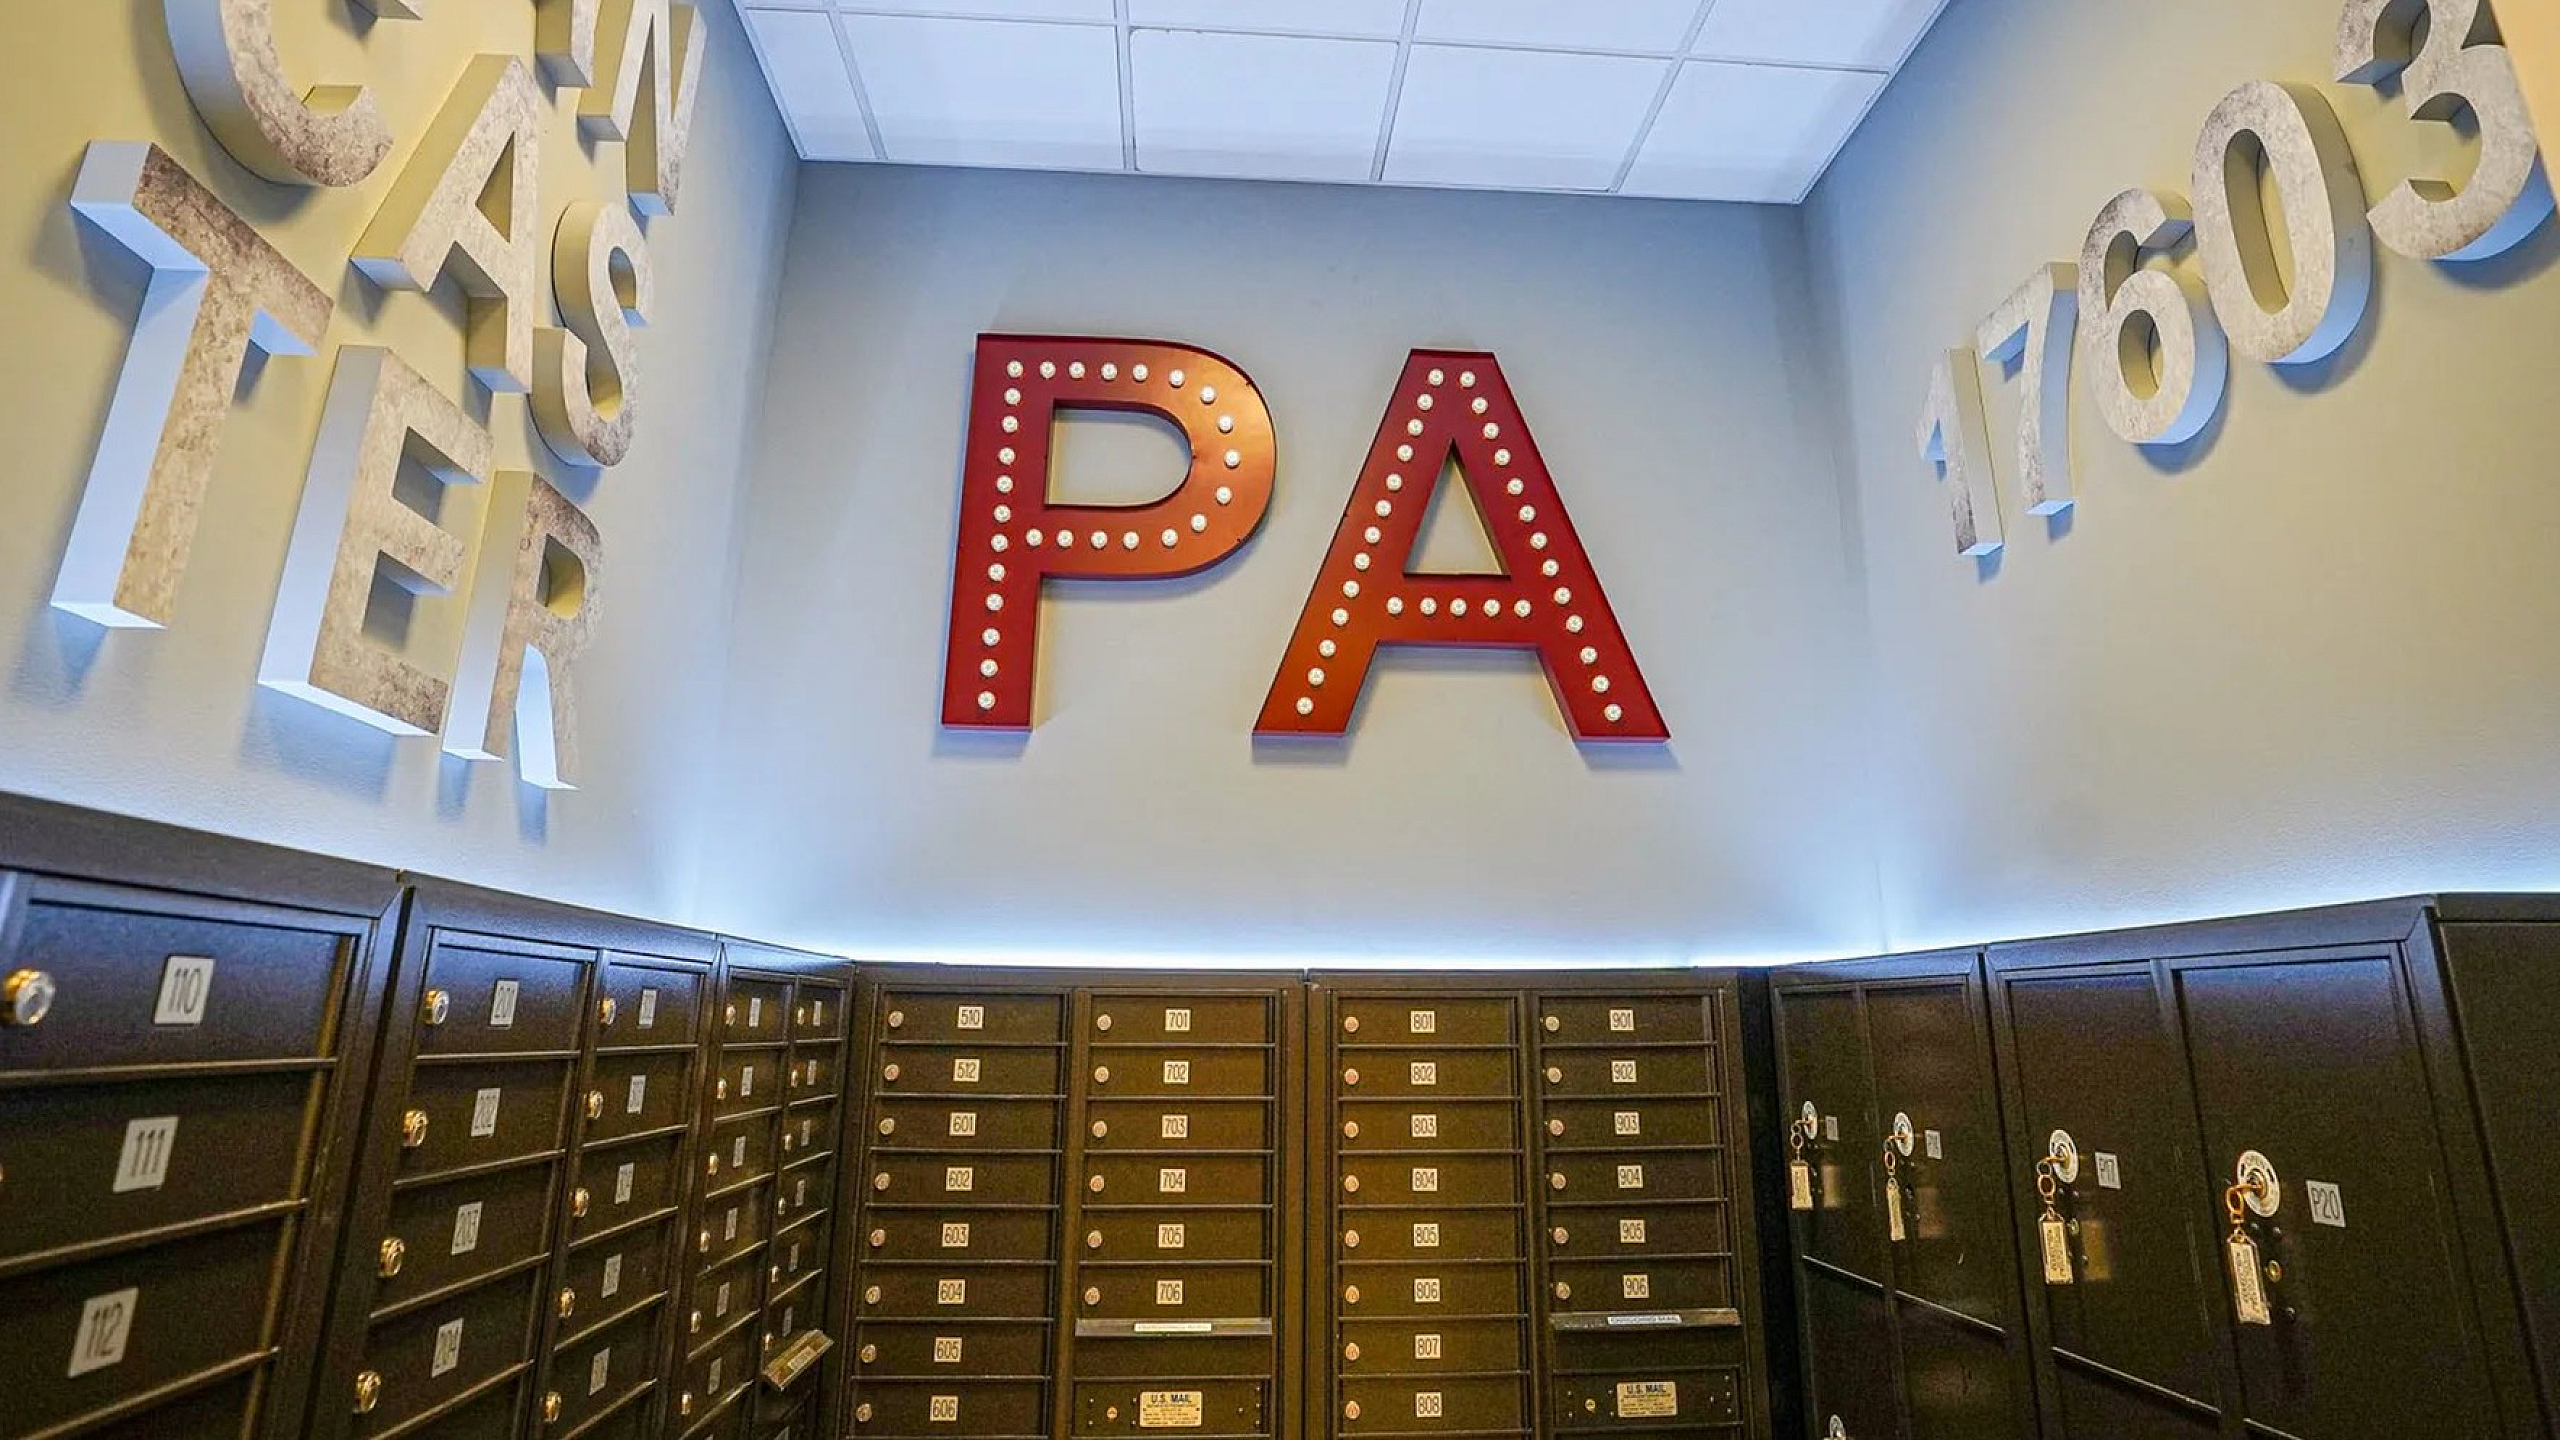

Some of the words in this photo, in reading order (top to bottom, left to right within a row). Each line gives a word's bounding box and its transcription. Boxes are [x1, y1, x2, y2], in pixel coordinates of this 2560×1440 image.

[1913, 0, 2554, 556] 17603
[942, 333, 1670, 741] PA
[168, 968, 204, 1015] 110
[960, 1009, 981, 1027] 510
[1168, 1011, 1188, 1029] 701
[1413, 1013, 1433, 1031] 801
[1611, 1012, 1632, 1029] 901
[956, 1061, 977, 1079] 512
[1166, 1063, 1187, 1082] 702
[1413, 1065, 1434, 1082] 802
[1613, 1062, 1634, 1080] 902
[952, 1114, 973, 1133] 601
[1164, 1117, 1186, 1135] 703
[1413, 1117, 1435, 1135] 803
[1616, 1114, 1638, 1132] 903
[131, 1129, 166, 1178] 111
[948, 1170, 970, 1189] 602
[1162, 1171, 1183, 1189] 704
[1414, 1170, 1435, 1189] 804
[1619, 1168, 1641, 1186] 904
[2310, 1187, 2341, 1219] P20
[944, 1226, 967, 1244] 603
[1161, 1226, 1182, 1245] 705
[1415, 1226, 1438, 1244] 805
[1622, 1222, 1644, 1241] 905
[940, 1282, 963, 1302] 604
[1160, 1282, 1181, 1302] 706
[1416, 1281, 1438, 1300] 806
[1625, 1277, 1647, 1296] 906
[86, 1302, 124, 1357] 112
[936, 1340, 960, 1360] 605
[1417, 1337, 1439, 1357] 807
[1170, 1393, 1192, 1403] MAIL
[1645, 1384, 1667, 1394] MAIL
[932, 1398, 956, 1419] 606
[1417, 1394, 1441, 1415] 808
